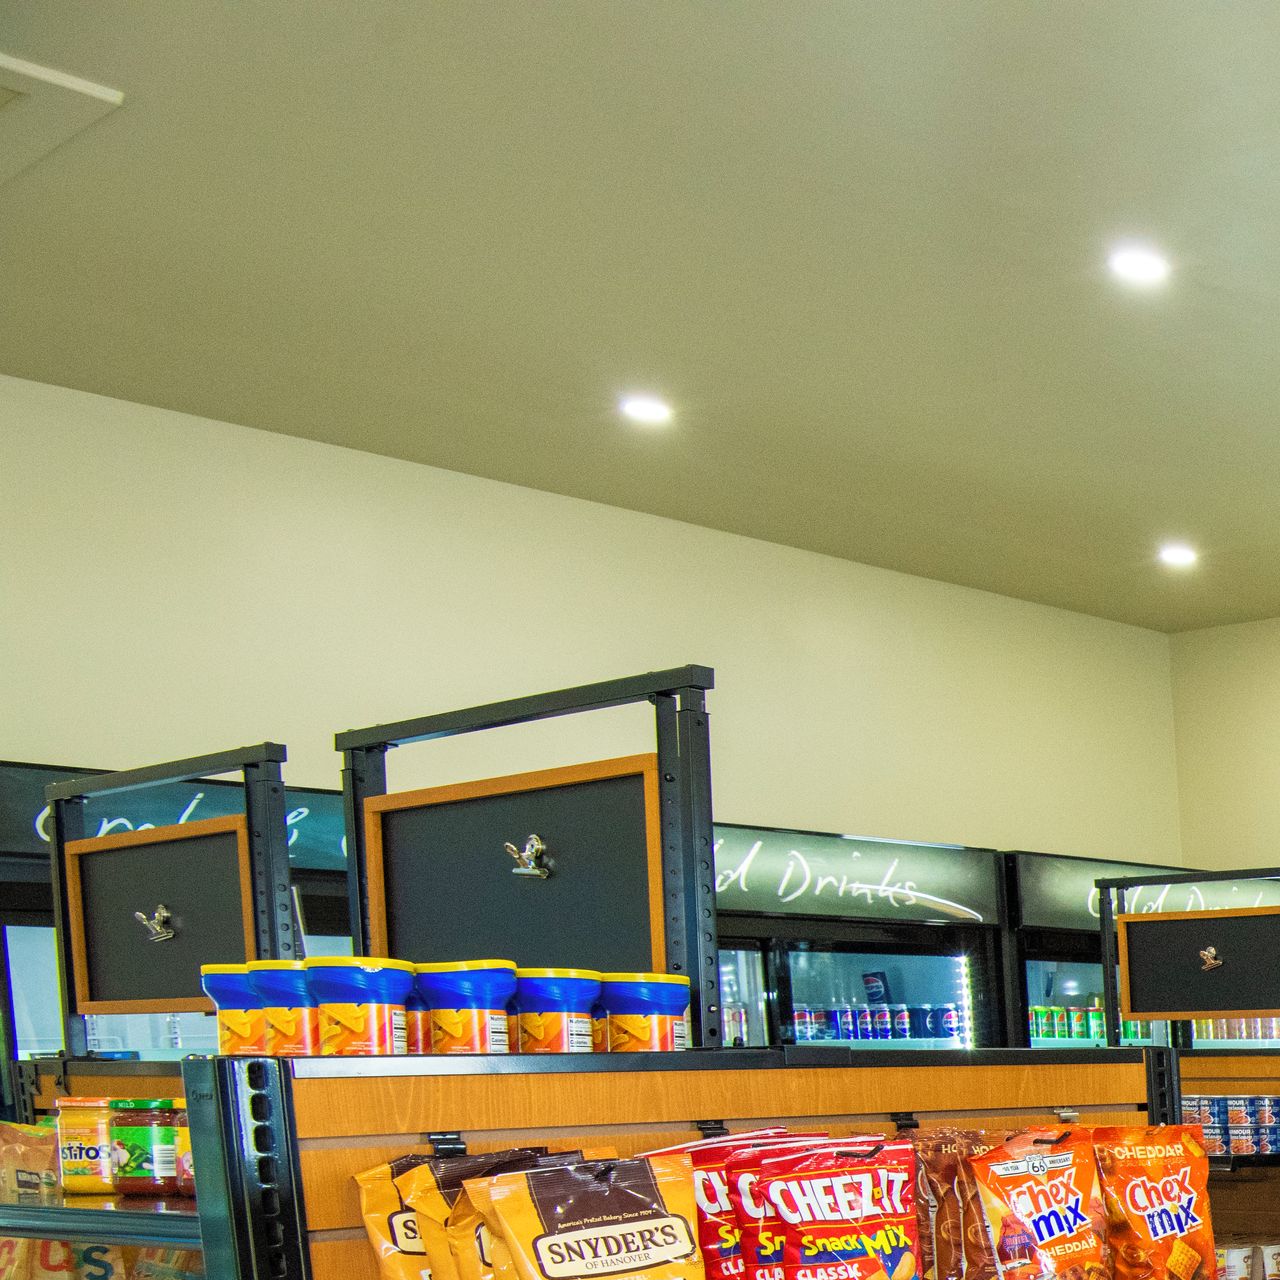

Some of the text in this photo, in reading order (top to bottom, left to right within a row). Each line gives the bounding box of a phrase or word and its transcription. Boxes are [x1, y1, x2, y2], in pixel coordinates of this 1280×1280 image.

[778, 851, 932, 907] Drinks
[1115, 1145, 1184, 1160] CHEDDAR
[1126, 1170, 1197, 1216] Chex
[1032, 1198, 1086, 1241] mix
[1147, 1196, 1201, 1240] mix
[548, 1224, 679, 1265] SNYDER'S
[586, 1253, 652, 1270] OF HANOVER
[802, 1234, 862, 1257] Snack
